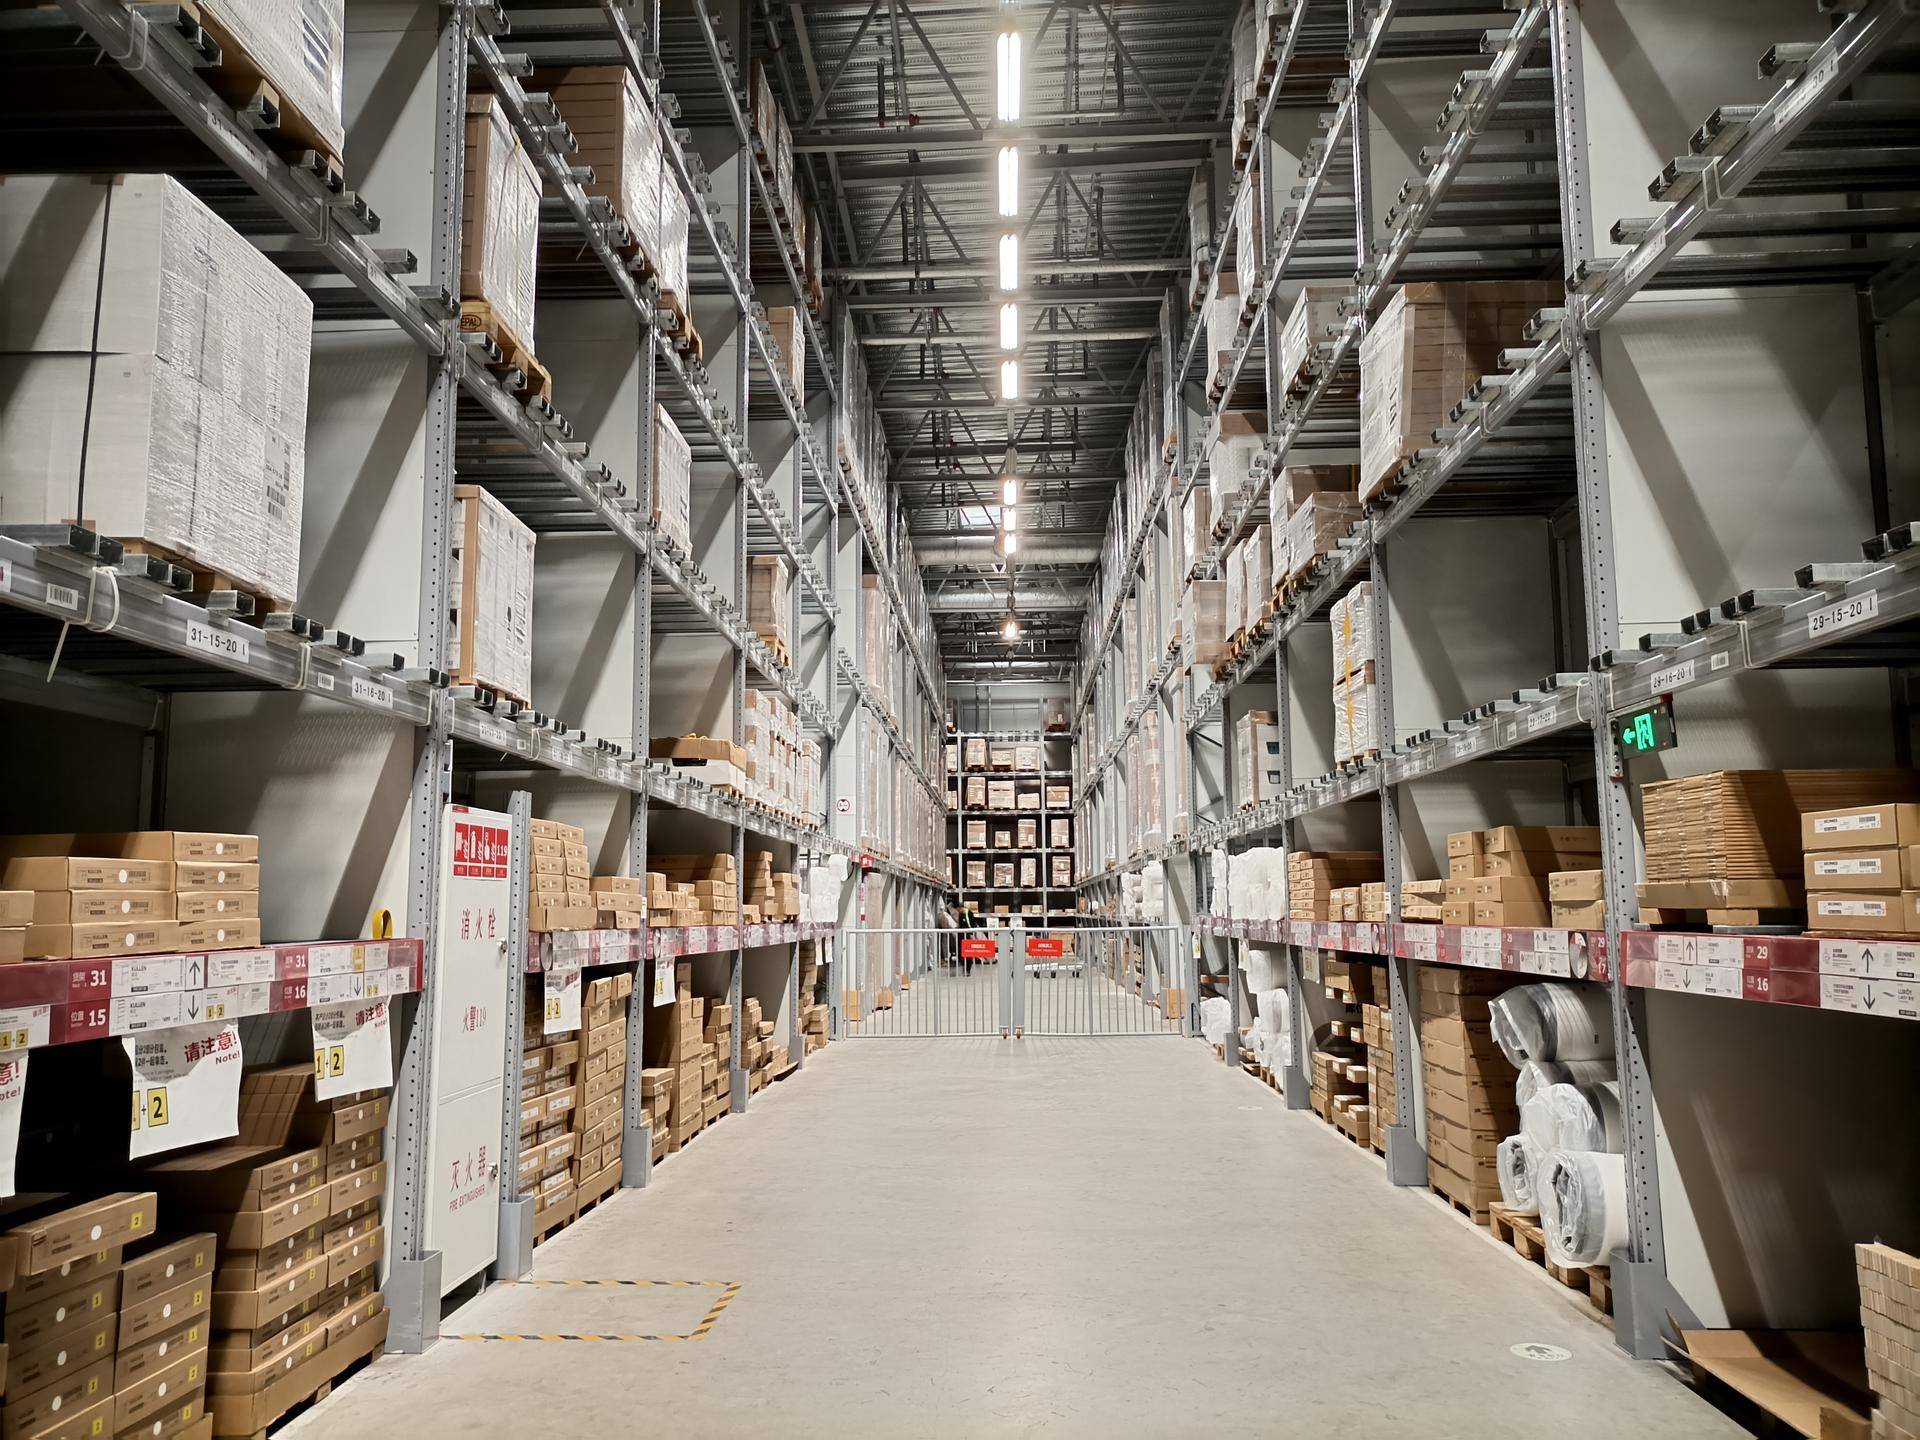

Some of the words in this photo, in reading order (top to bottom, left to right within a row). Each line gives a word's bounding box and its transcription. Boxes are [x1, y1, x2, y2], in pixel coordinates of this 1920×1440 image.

[1813, 601, 1862, 630] 29-15-20
[191, 628, 237, 653] 31-15-20
[1654, 667, 1684, 688] 29-16-20
[355, 682, 385, 701] 31-16-20
[496, 845, 507, 857] 119
[461, 908, 496, 940] 消火栓
[295, 955, 306, 968] 31
[1757, 945, 1768, 959] 29
[90, 970, 108, 987] 31
[1757, 977, 1768, 991] 16
[295, 985, 306, 999] 16
[88, 1008, 106, 1027] 15
[2, 1035, 8, 1047] 1
[19, 1033, 25, 1044] 2
[184, 1030, 238, 1063] 请注意!
[215, 1050, 240, 1065] Note!
[316, 1055, 321, 1074] 1
[333, 1052, 340, 1071] 2
[153, 1096, 163, 1119] 2
[450, 1145, 486, 1193] 灭火器
